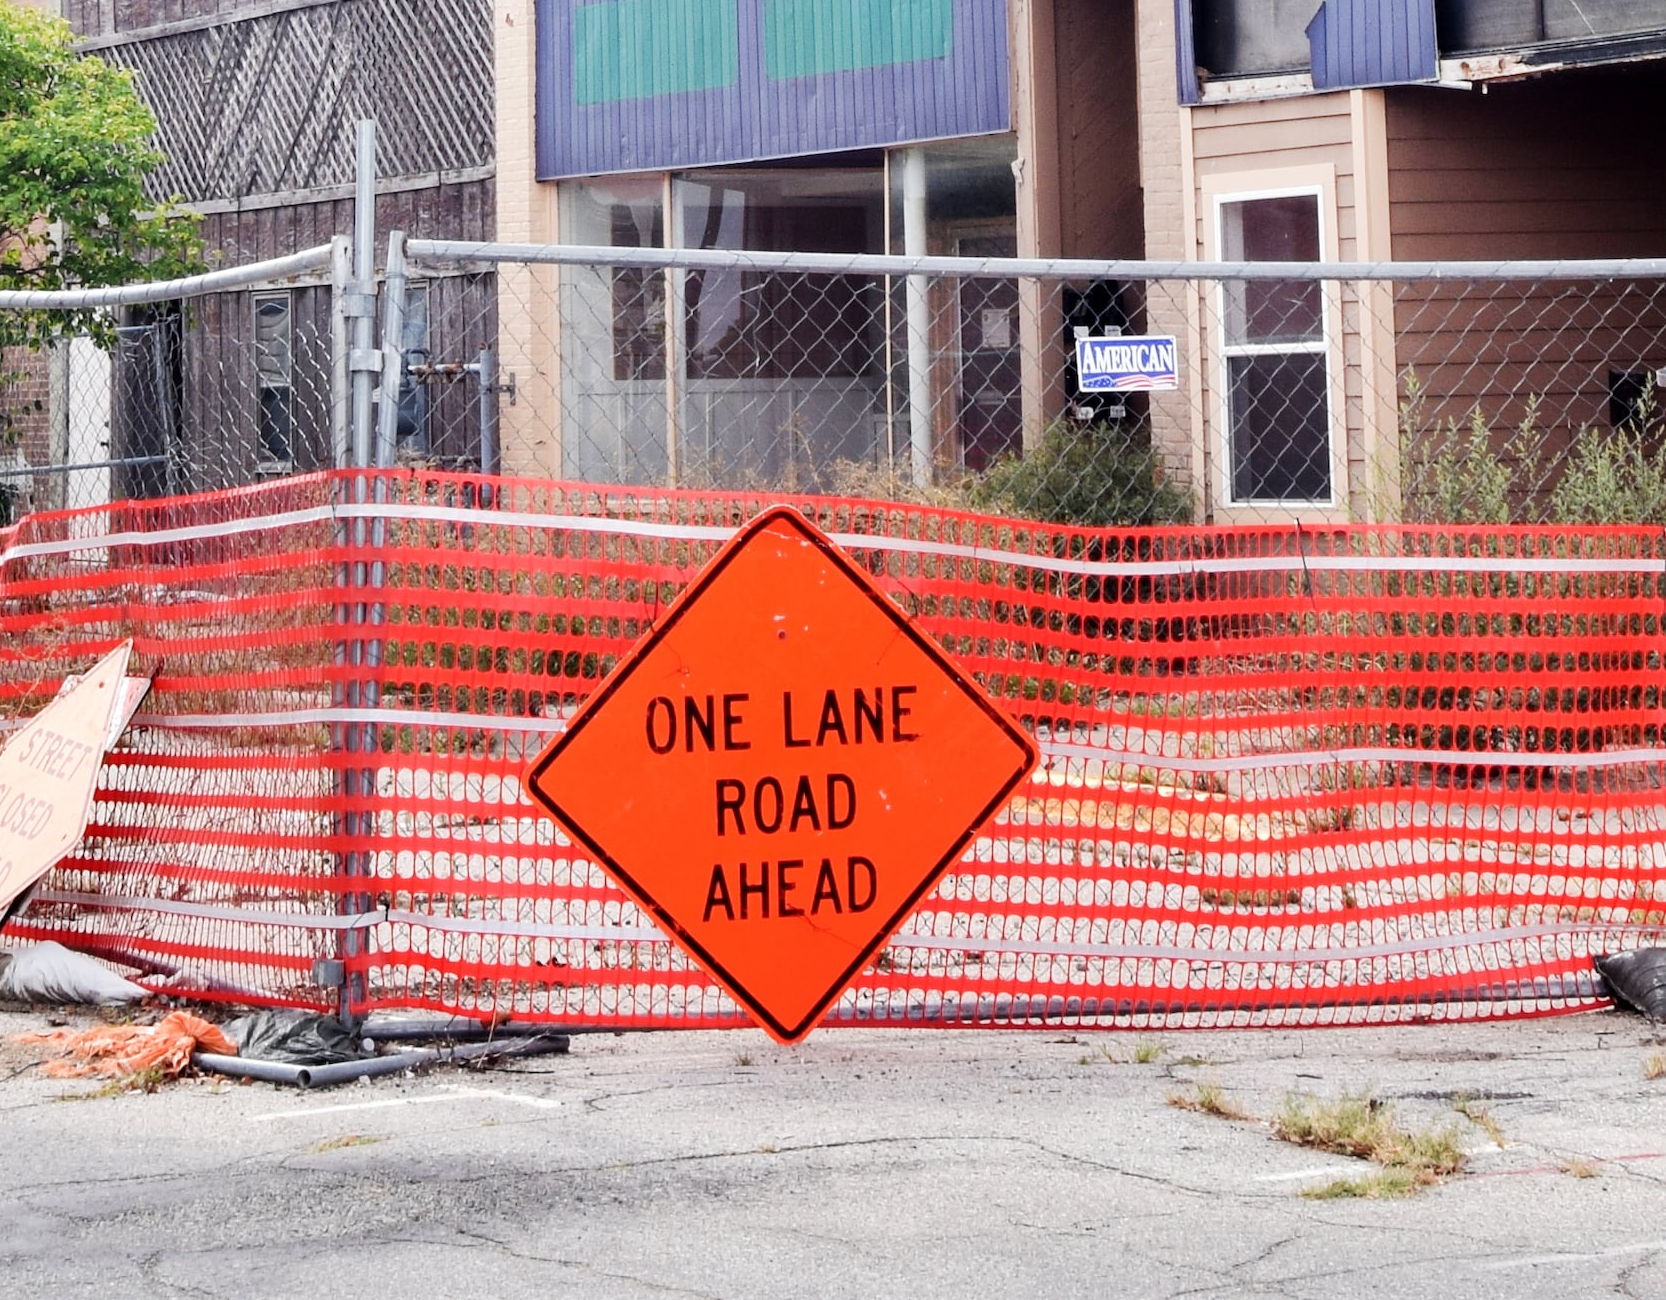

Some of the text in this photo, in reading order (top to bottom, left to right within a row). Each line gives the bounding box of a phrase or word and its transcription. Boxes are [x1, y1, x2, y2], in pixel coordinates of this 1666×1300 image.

[1082, 341, 1173, 374] AMERICAN
[646, 686, 919, 755] ONE LANE
[19, 727, 94, 781] STREET
[716, 773, 857, 836] ROAD
[702, 856, 878, 922] AHEAD
